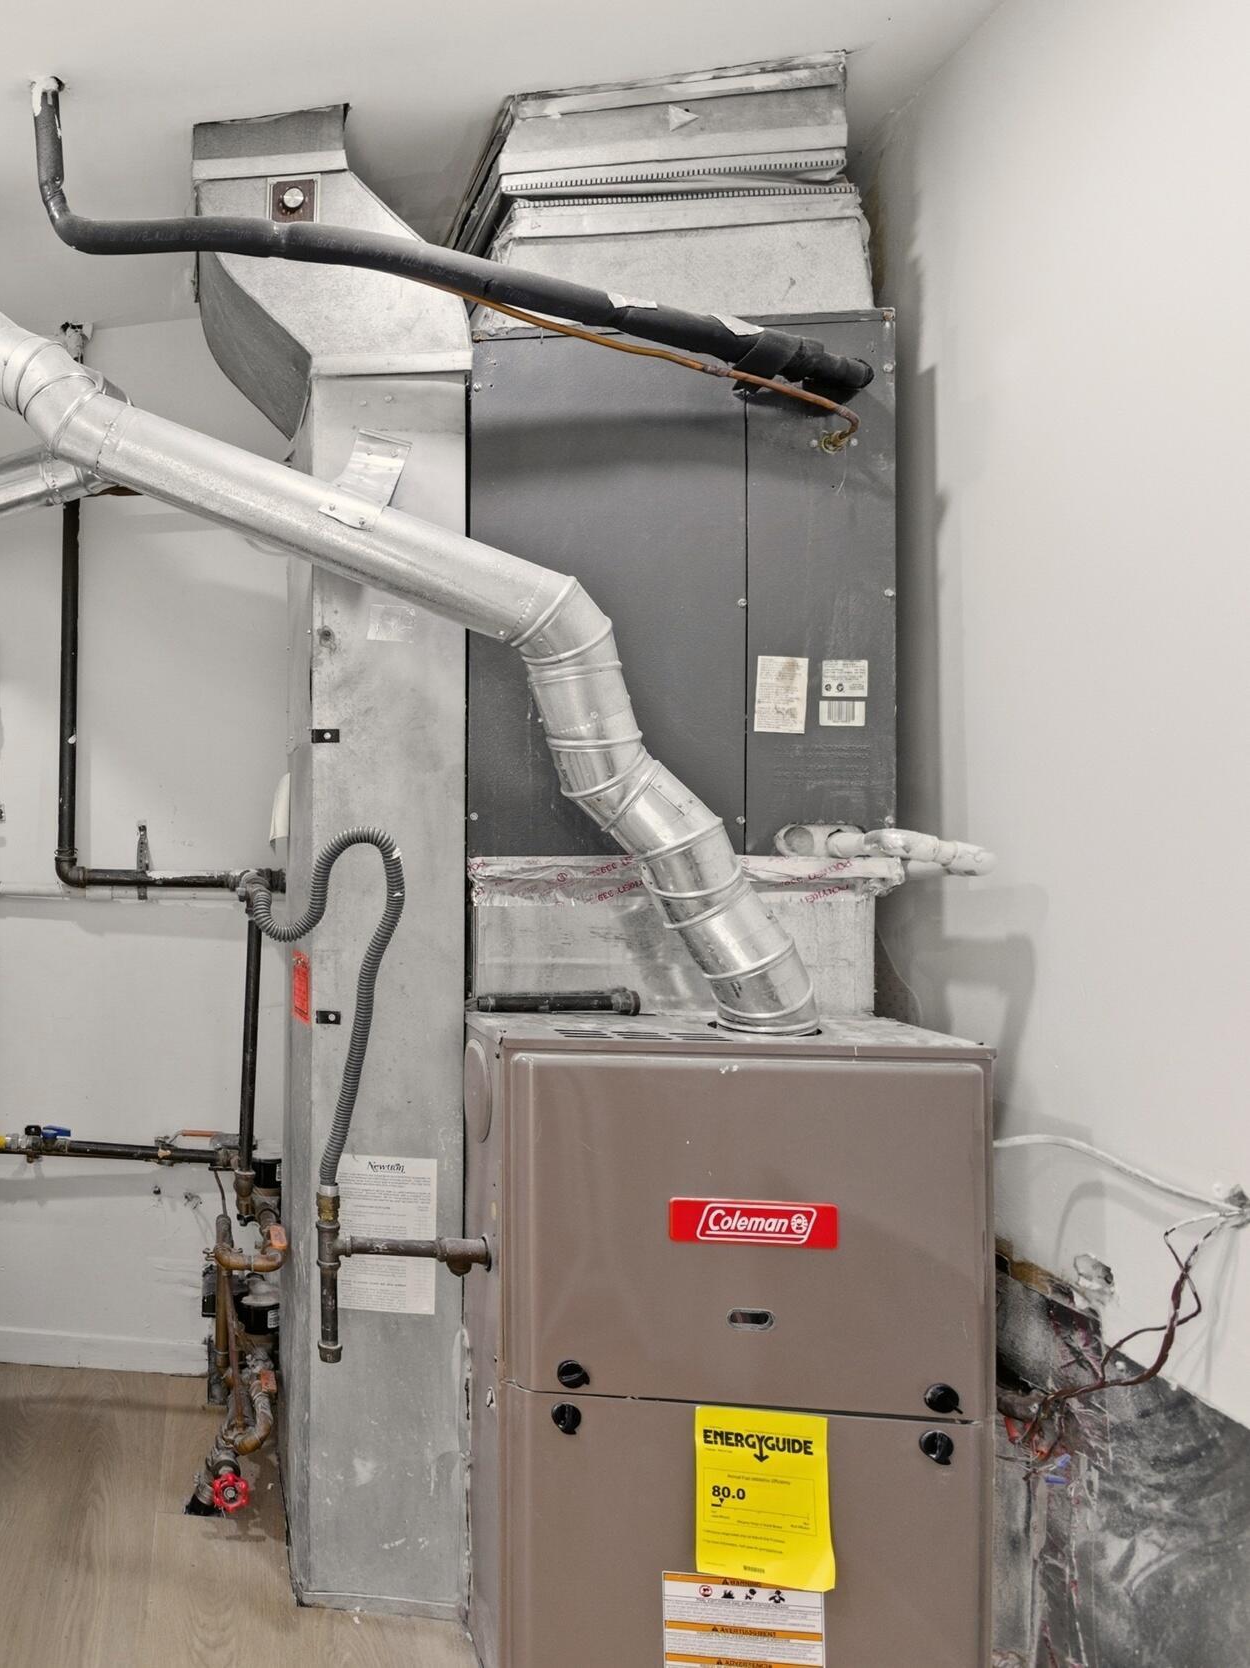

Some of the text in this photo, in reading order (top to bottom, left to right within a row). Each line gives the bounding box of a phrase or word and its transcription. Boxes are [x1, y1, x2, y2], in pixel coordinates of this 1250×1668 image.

[708, 1209, 789, 1233] Coleman
[703, 1428, 814, 1457] ENERGYGUIDE
[712, 1485, 746, 1501] 80.0
